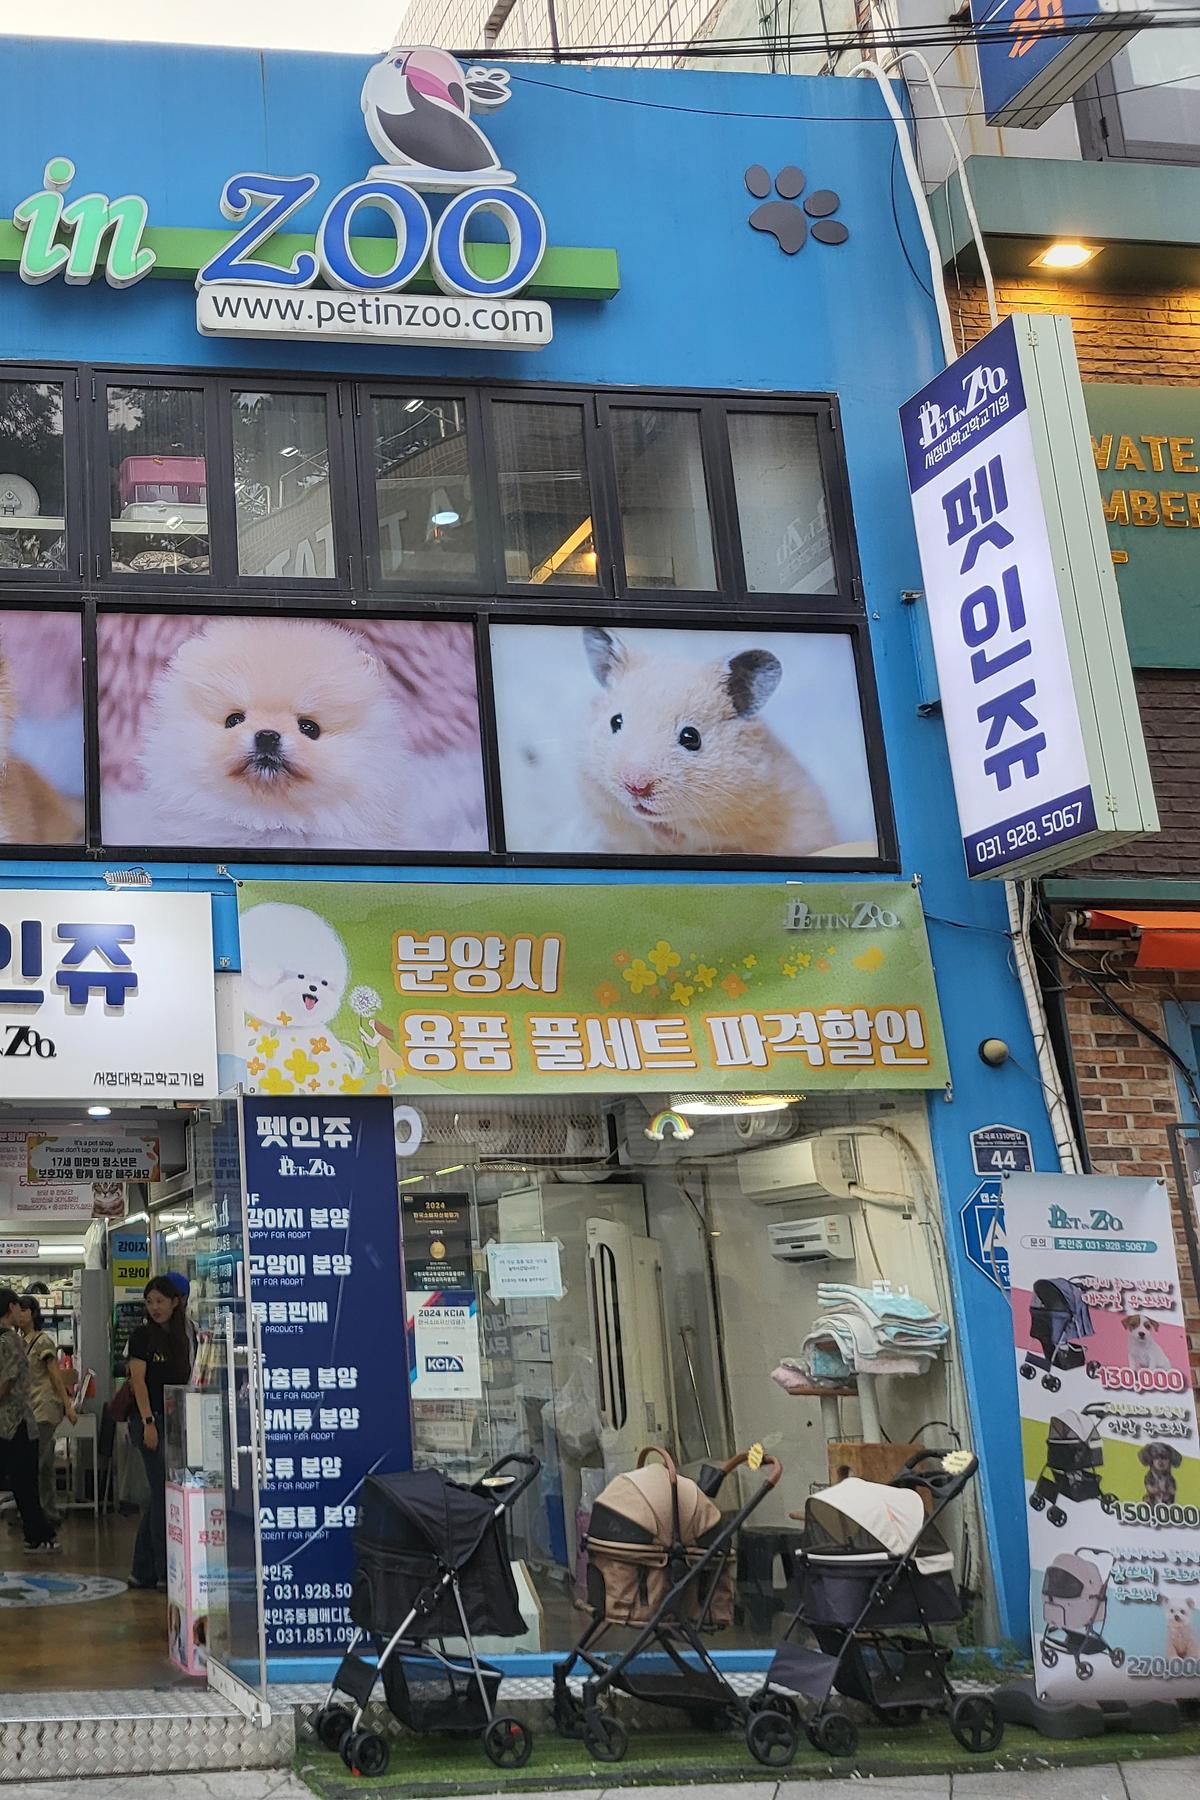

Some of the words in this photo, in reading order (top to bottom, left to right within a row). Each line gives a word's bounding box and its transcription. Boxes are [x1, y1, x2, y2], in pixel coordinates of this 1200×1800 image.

[13, 157, 156, 289] in
[199, 172, 547, 298] ZOO
[213, 291, 545, 335] www.petinzoo.com
[925, 393, 1010, 469] 서정대학교학교기업
[940, 455, 1045, 791] 펫인쥬
[396, 934, 560, 994] 분양시
[402, 1012, 511, 1072] 용품
[531, 1013, 697, 1072] 풀세트
[706, 1009, 928, 1068] 파격할인
[93, 1071, 205, 1087] 서정대학교학교기업
[256, 1116, 352, 1148] 펫인쥬
[990, 1150, 1016, 1169] 44
[247, 1208, 303, 1229] 강아지
[310, 1208, 349, 1229] 분양
[1030, 1237, 1047, 1247] 문의
[1086, 1241, 1147, 1252] 031-928-5067
[250, 1255, 306, 1276] 고양이
[313, 1255, 352, 1276] 분양
[418, 1309, 441, 1317] 2024
[444, 1309, 465, 1317] KCIA
[427, 1358, 461, 1372] KCIA
[318, 1368, 358, 1390] 분양
[1097, 1367, 1183, 1390] 130,000
[320, 1408, 360, 1430] 분양
[1143, 1421, 1189, 1436] 유모차
[302, 1456, 341, 1478] 분양
[1112, 1502, 1198, 1526] 150,000
